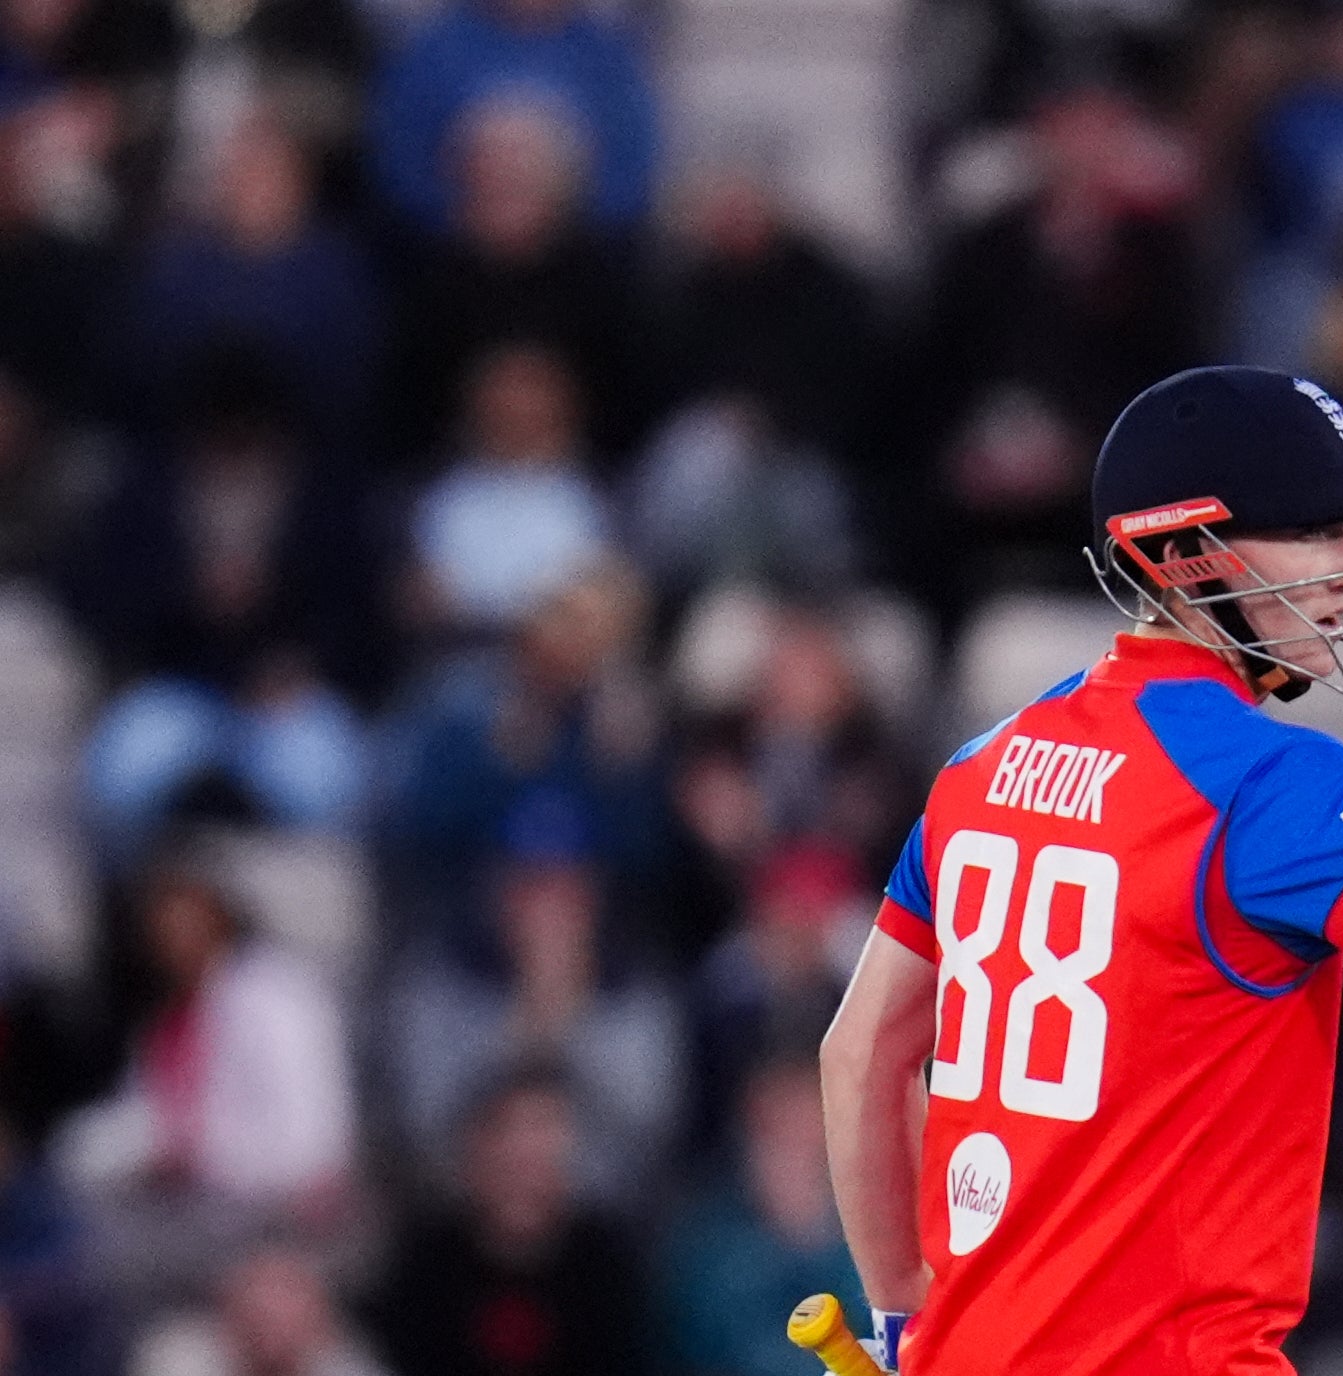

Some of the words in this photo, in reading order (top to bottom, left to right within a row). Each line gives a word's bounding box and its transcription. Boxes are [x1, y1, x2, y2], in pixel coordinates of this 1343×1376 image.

[985, 734, 1128, 824] BROOK
[929, 829, 1120, 1122] 88
[951, 1162, 1004, 1231] Vitality
